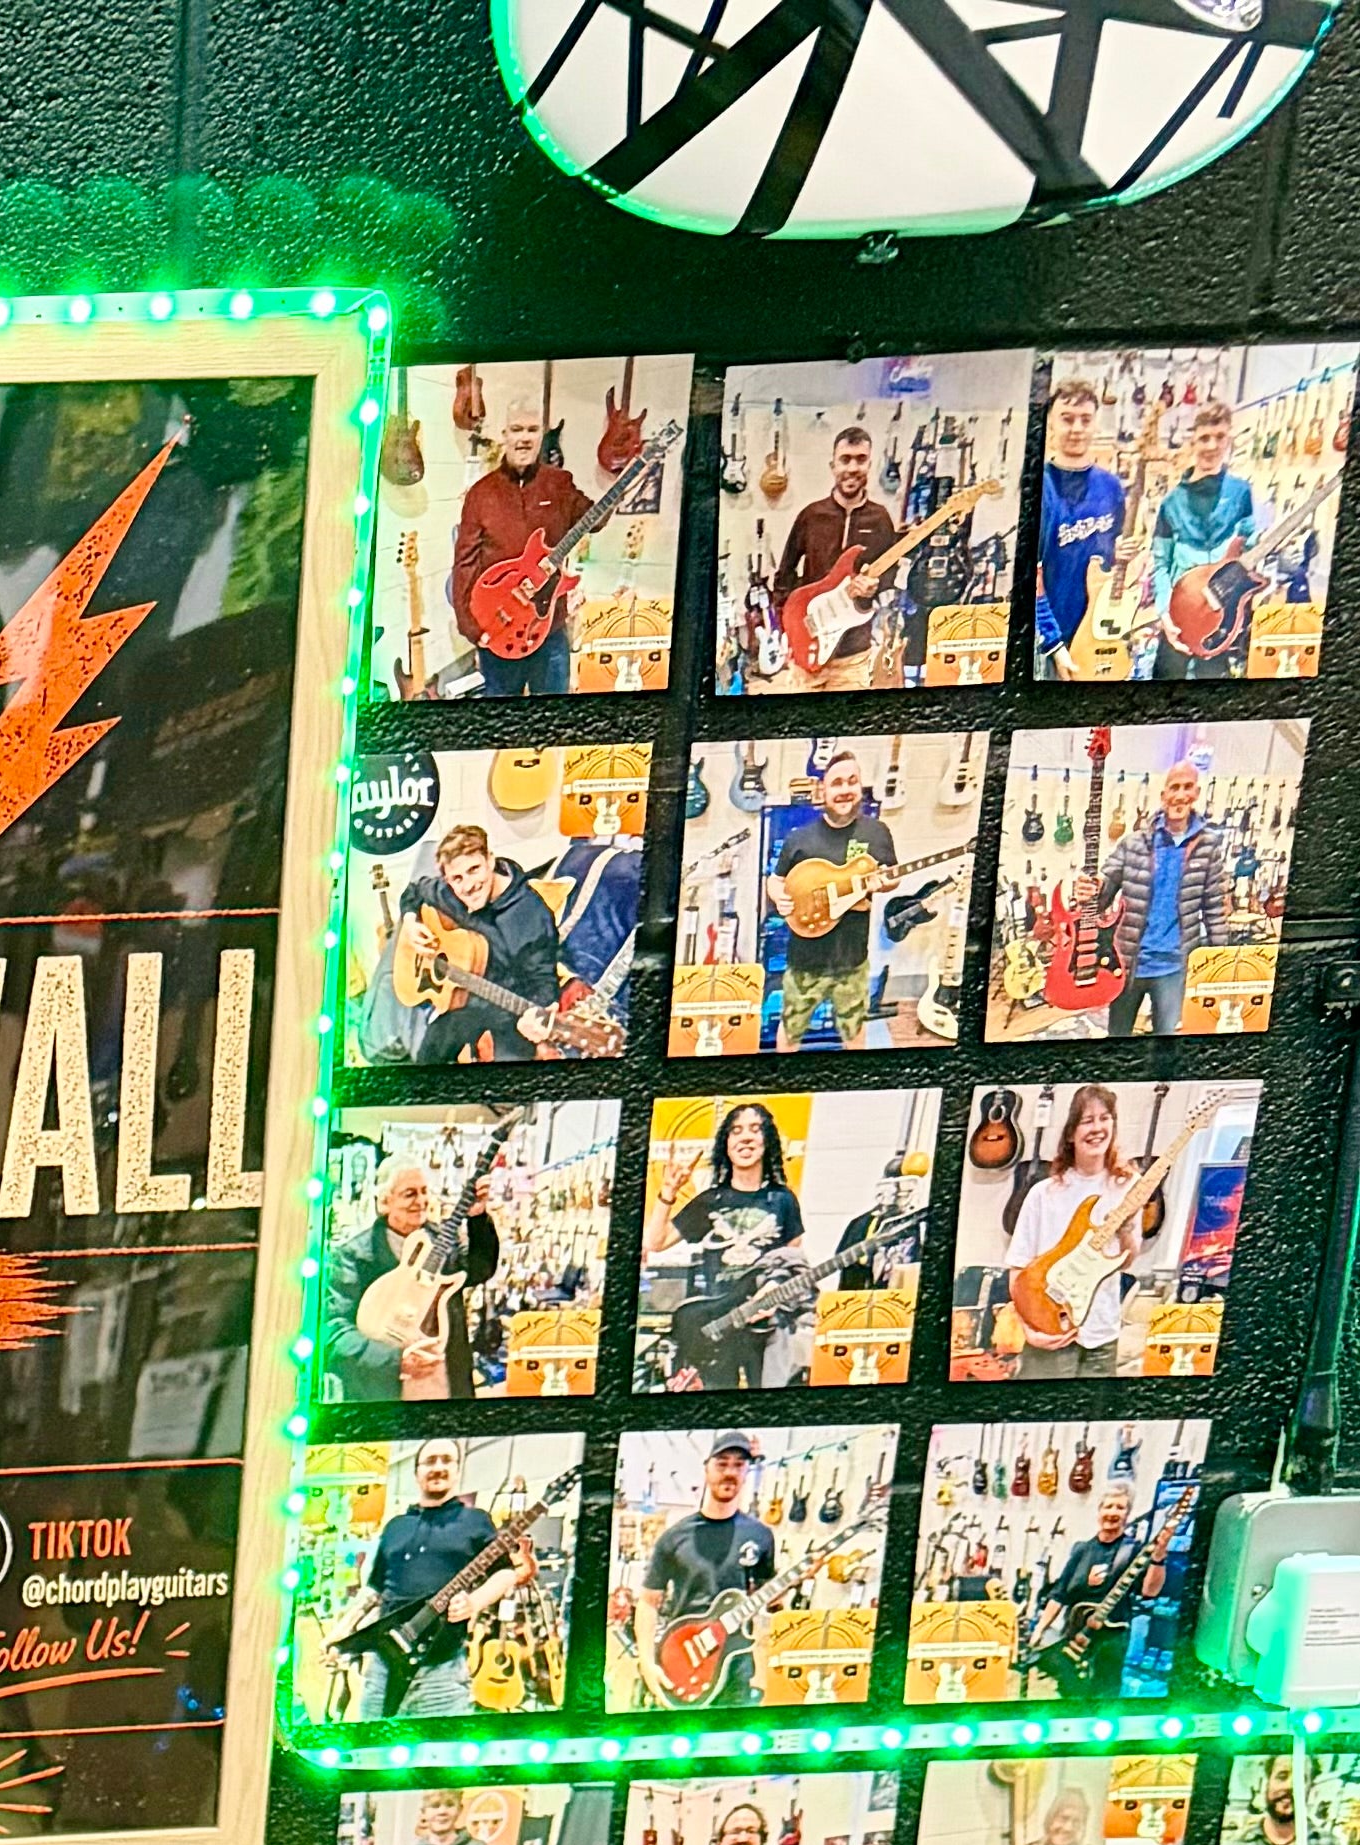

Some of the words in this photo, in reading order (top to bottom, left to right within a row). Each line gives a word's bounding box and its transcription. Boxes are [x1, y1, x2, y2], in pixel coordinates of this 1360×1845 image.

[351, 765, 435, 820] aylor
[28, 1517, 133, 1561] TIKTOK
[21, 1568, 228, 1608] @chordplayguitars
[87, 1609, 147, 1663] Us!
